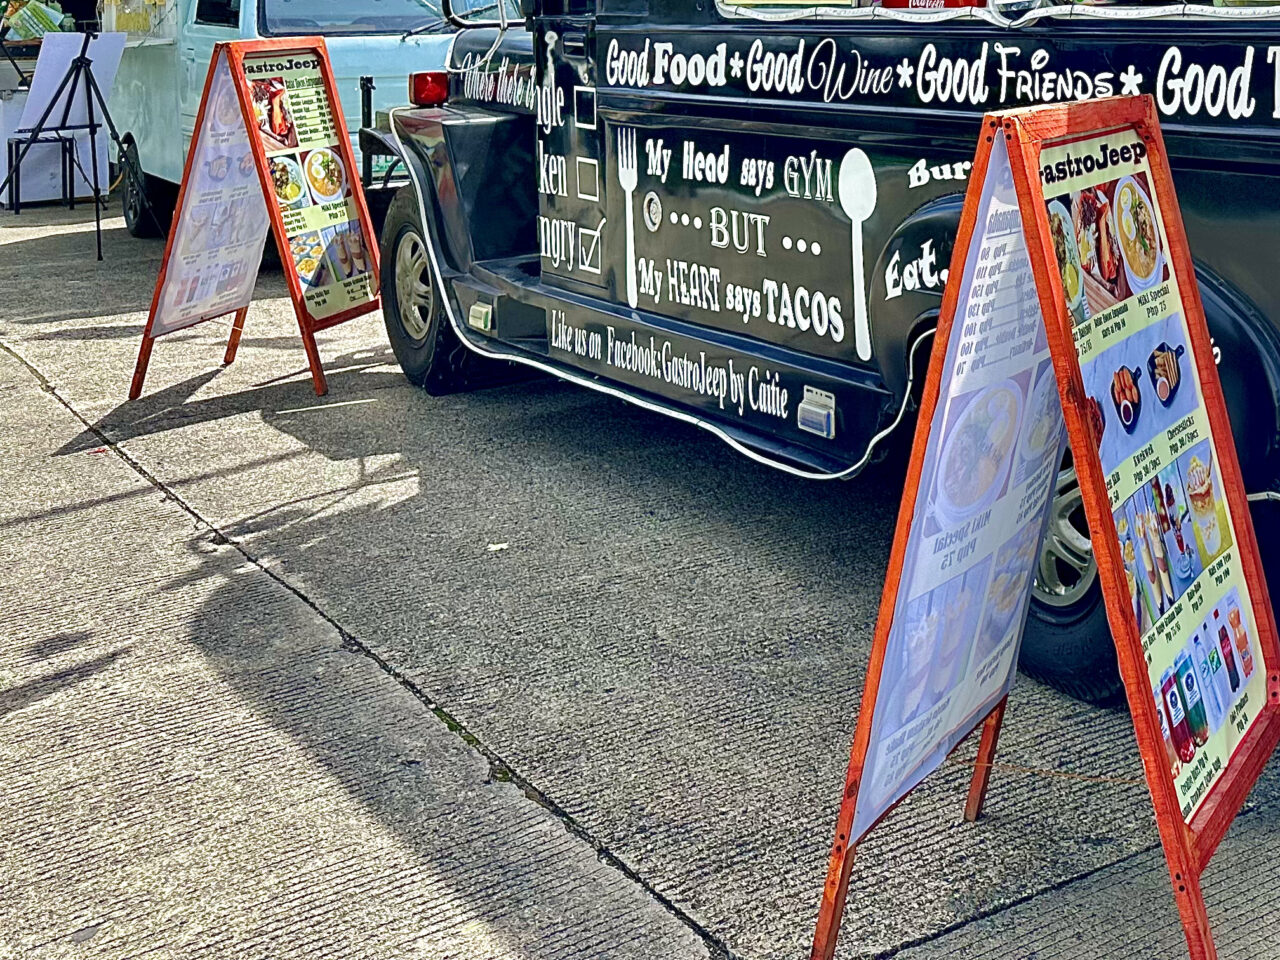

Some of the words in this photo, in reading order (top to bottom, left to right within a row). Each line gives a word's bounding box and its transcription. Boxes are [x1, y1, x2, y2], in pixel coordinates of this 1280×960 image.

[605, 37, 650, 87] Good
[652, 42, 728, 87] Food
[745, 39, 807, 95] Good
[807, 37, 894, 104] Wine
[915, 42, 990, 105] Good
[1155, 44, 1256, 121] Good
[645, 138, 672, 177] My
[682, 140, 730, 185] Head
[740, 154, 775, 197] says
[782, 149, 834, 204] GYM
[1039, 141, 1148, 186] astroJeep
[708, 207, 771, 258] BUT
[637, 258, 664, 305] My
[666, 258, 721, 314] HEART
[725, 283, 761, 325] says
[761, 278, 846, 344] TACOS
[1146, 303, 1160, 319] Php
[550, 309, 575, 355] Like
[574, 319, 588, 356] us
[588, 326, 602, 362] on
[726, 369, 746, 417] by
[747, 365, 789, 420] Caitie
